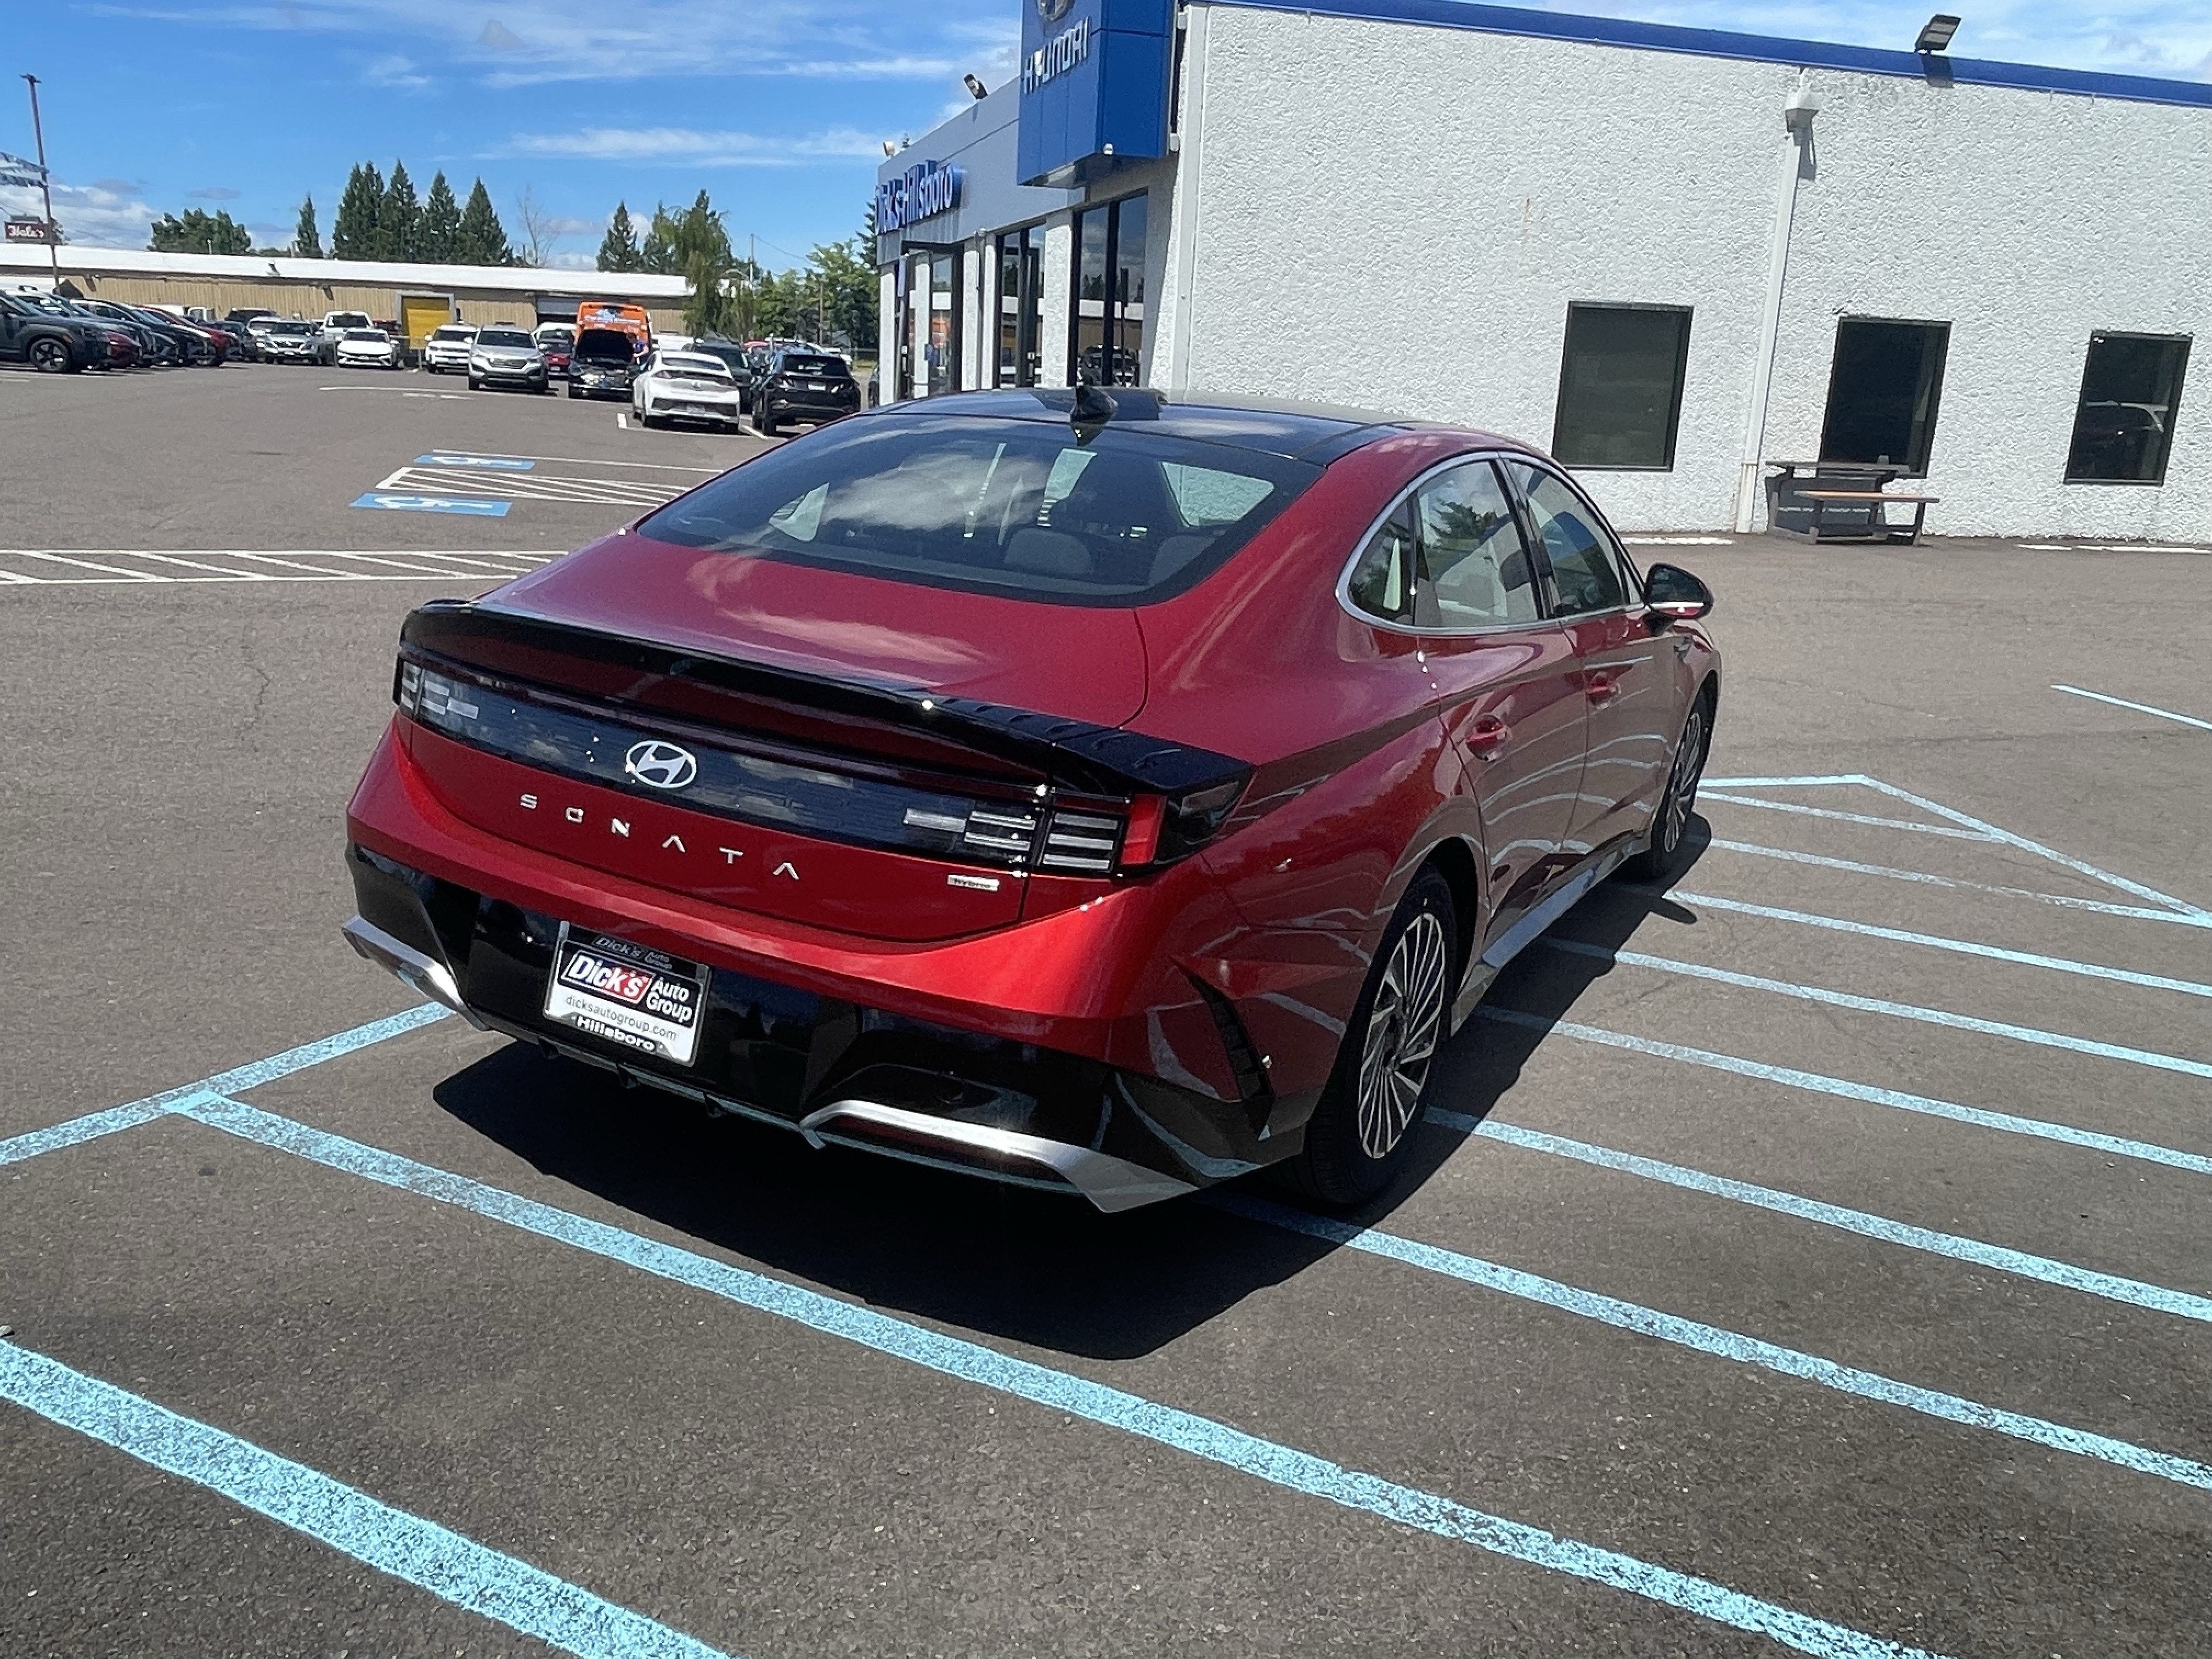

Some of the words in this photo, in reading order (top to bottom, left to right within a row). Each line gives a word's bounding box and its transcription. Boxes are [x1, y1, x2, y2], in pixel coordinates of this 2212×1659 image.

[1024, 15, 1089, 94] HYUNDAI
[520, 793, 800, 881] SONATA
[567, 955, 645, 997] Dick's
[652, 977, 690, 1002] Auto
[565, 994, 677, 1041] dicksautogroup.com
[646, 992, 692, 1023] Group
[577, 1015, 656, 1051] Hillsboro
